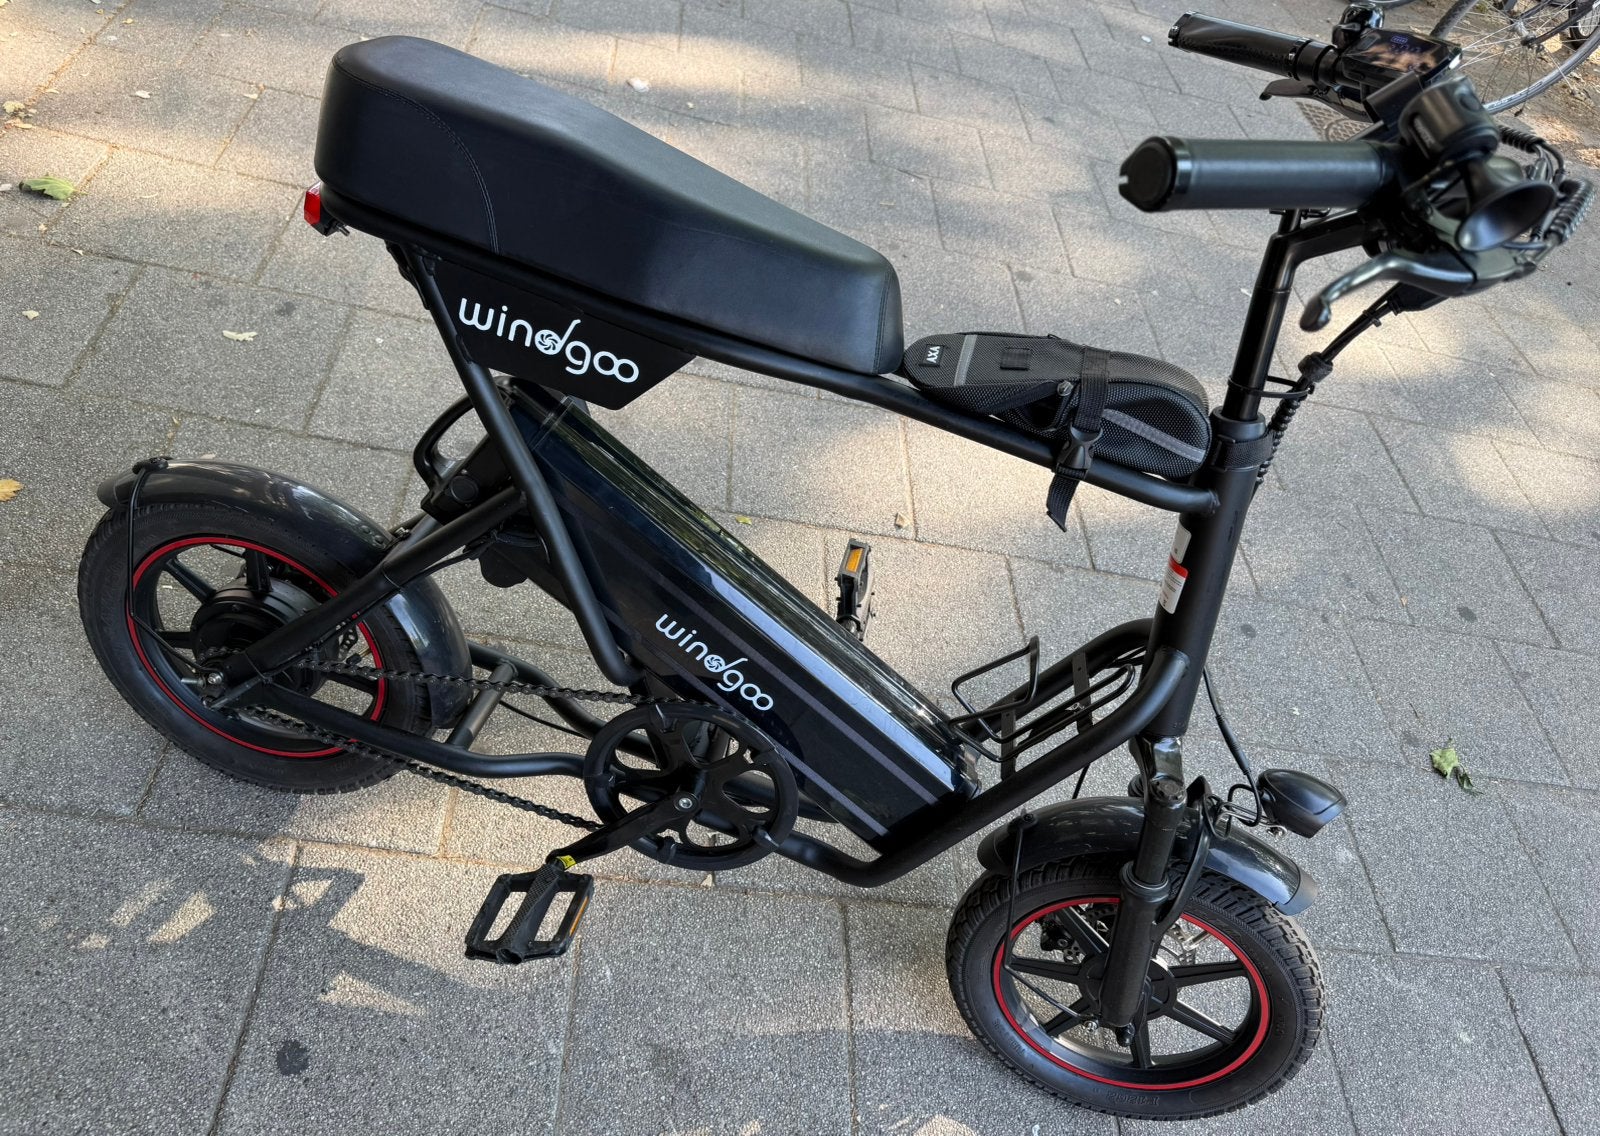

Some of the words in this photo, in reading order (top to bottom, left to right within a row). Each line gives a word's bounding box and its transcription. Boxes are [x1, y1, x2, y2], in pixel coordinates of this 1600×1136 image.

[458, 297, 640, 383] windgoo
[926, 345, 941, 364] AXA
[655, 613, 774, 711] windgoo
